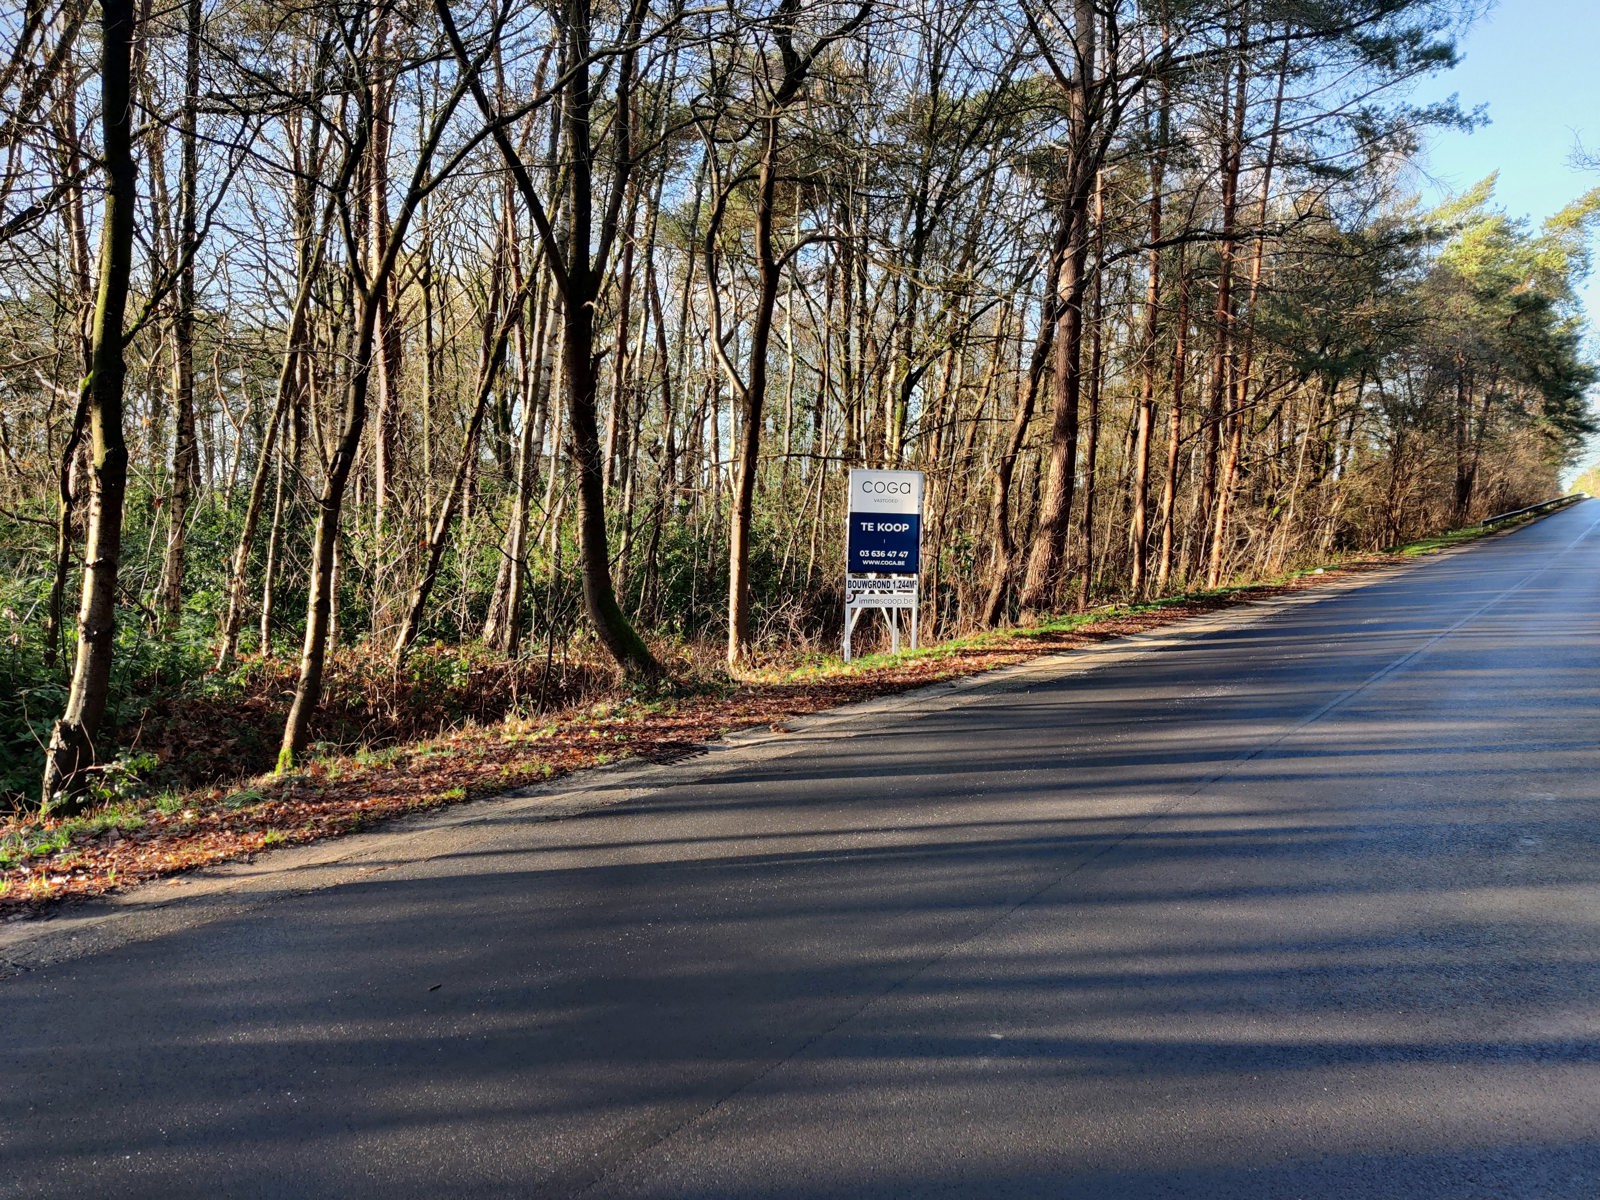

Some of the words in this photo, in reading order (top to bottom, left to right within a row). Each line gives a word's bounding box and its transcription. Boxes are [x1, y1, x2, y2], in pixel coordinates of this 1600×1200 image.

[860, 522, 875, 532] TE
[877, 522, 910, 533] KOOP
[859, 549, 870, 557] 03
[871, 550, 886, 558] 636
[887, 550, 897, 558] 47
[847, 579, 891, 589] BOUWGROND
[858, 597, 914, 605] immoscoop.be
